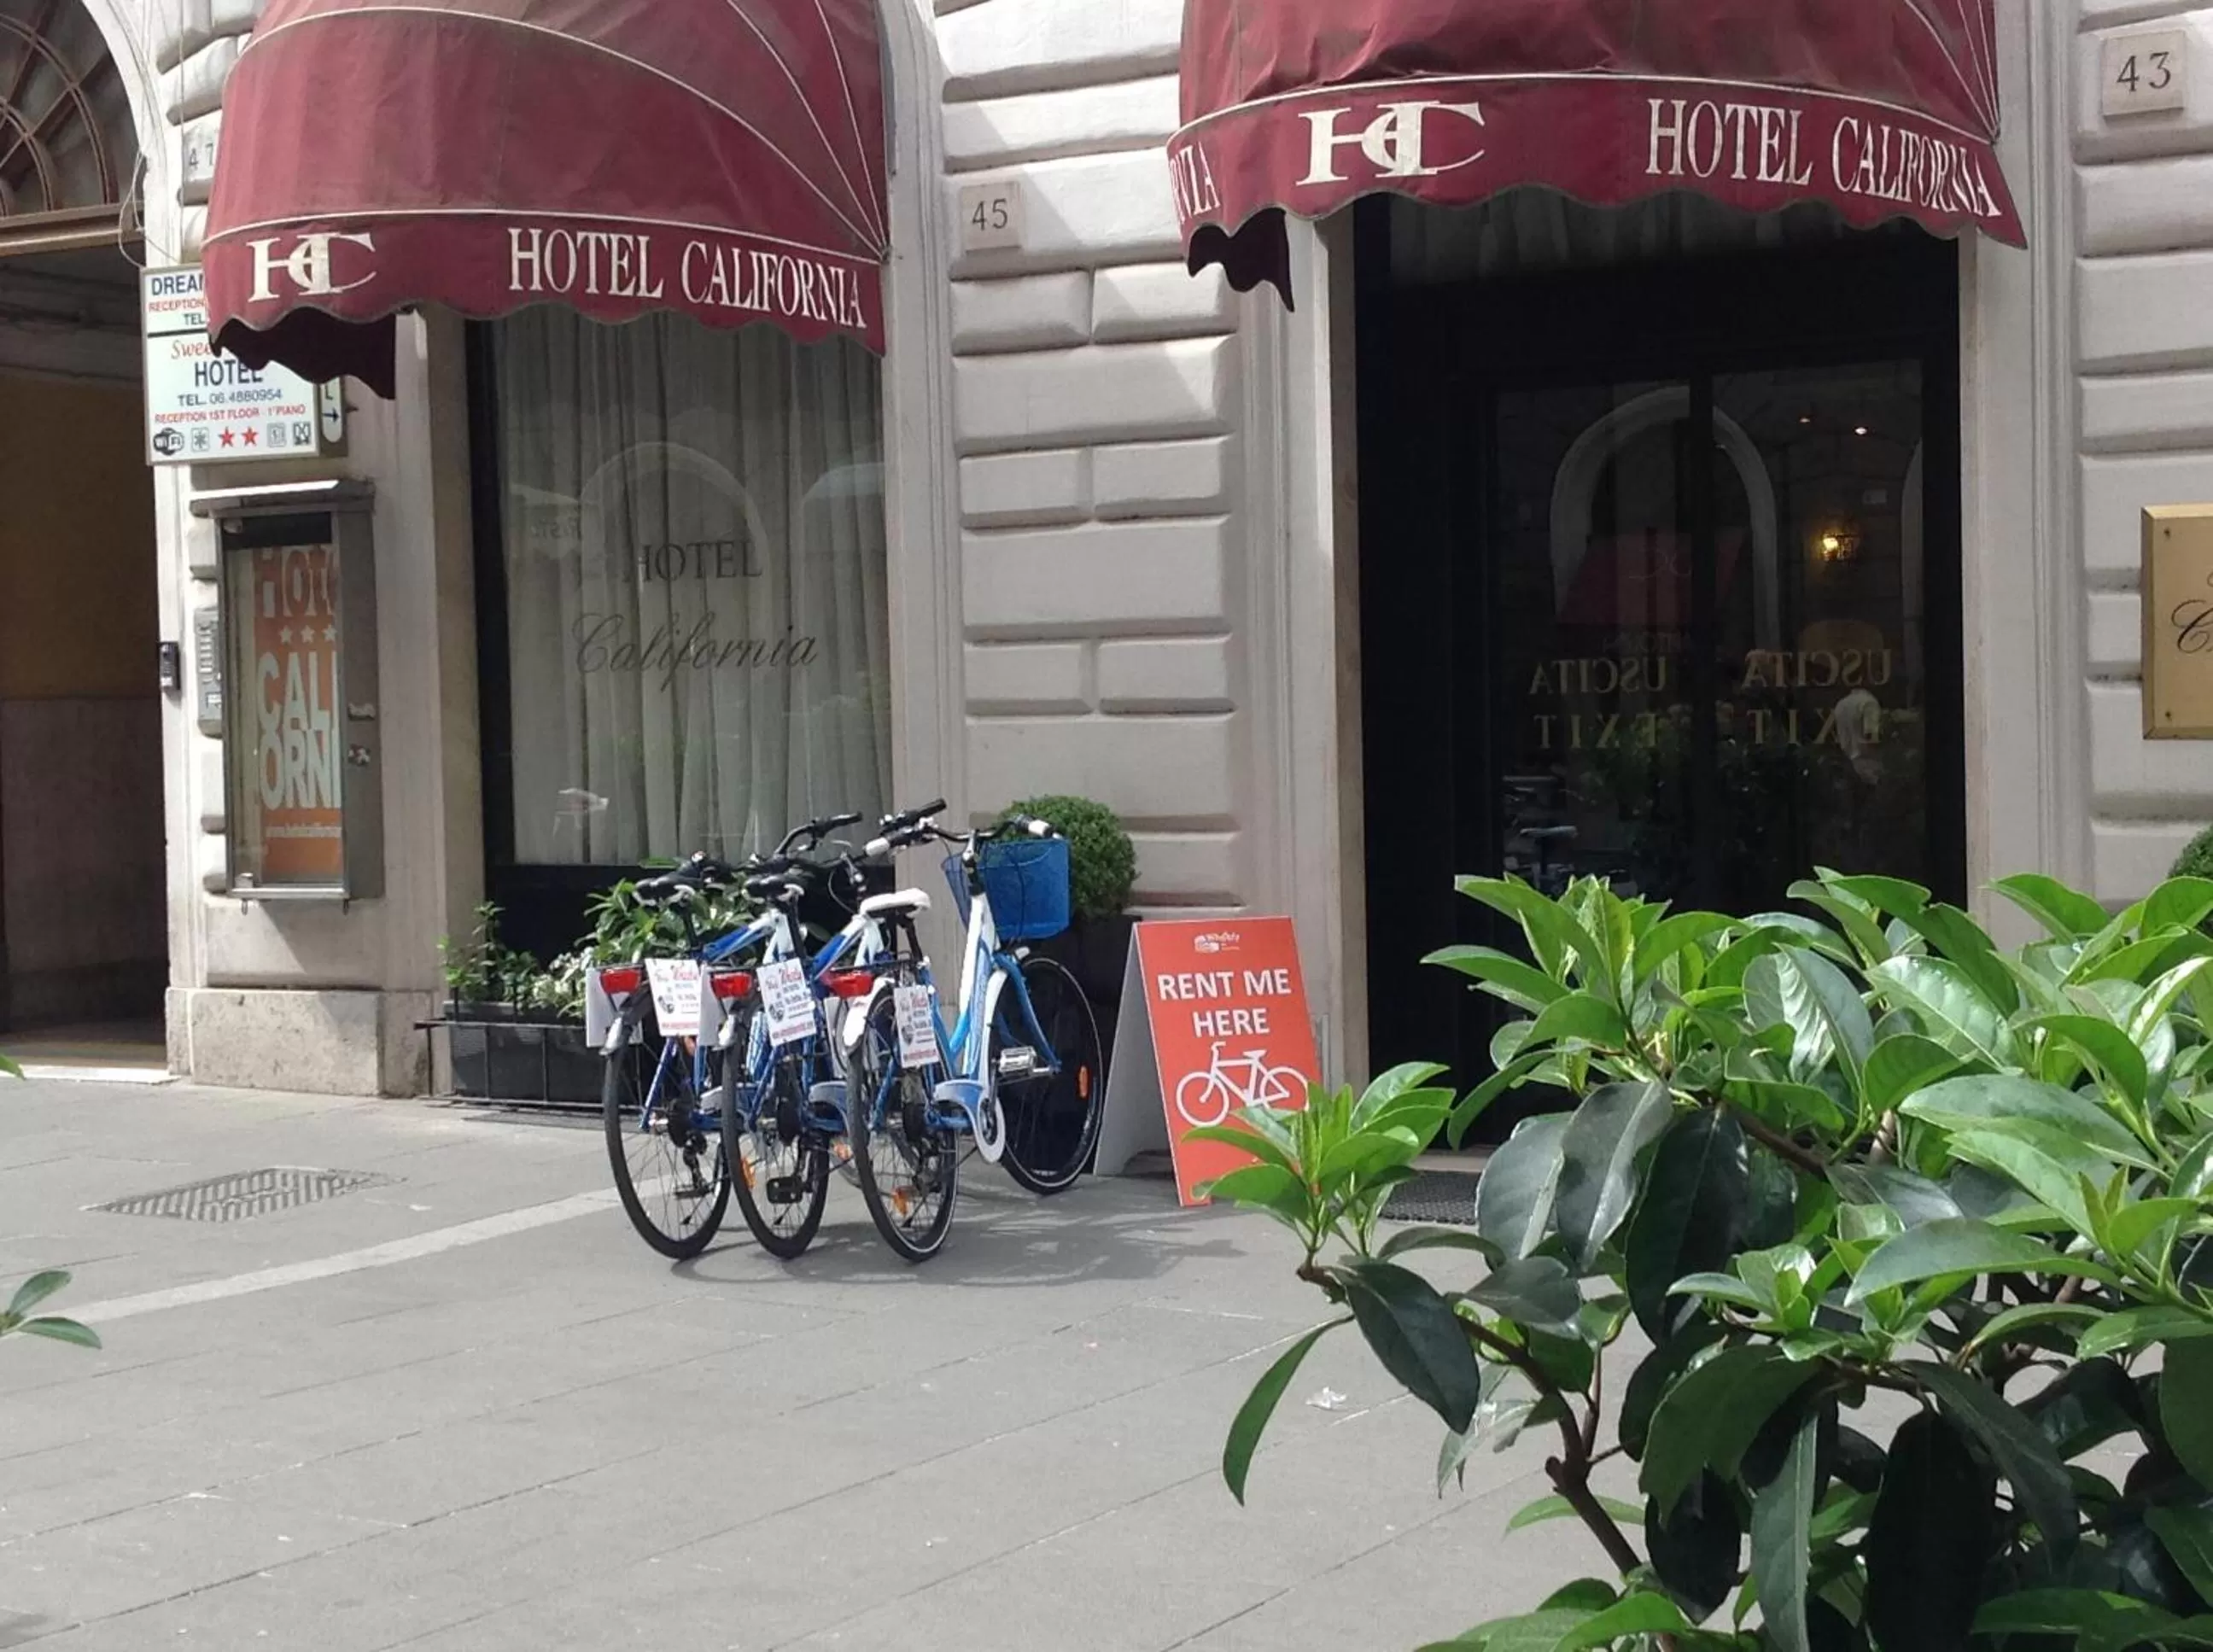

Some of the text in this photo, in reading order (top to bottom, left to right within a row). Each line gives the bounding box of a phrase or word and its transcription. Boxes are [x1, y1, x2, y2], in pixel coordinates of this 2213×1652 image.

[2116, 51, 2172, 92] 43
[188, 143, 214, 171] 47
[1645, 98, 2003, 218] HOTEL CALIFORNIA
[972, 198, 1008, 231] 45
[507, 227, 867, 329] HOTEL CALIFORNIA
[195, 359, 264, 388] HOTEL
[622, 538, 763, 584] HOTEL
[572, 610, 819, 693] California
[1157, 968, 1292, 1001] RENT ME
[1192, 1007, 1270, 1038] HERE
